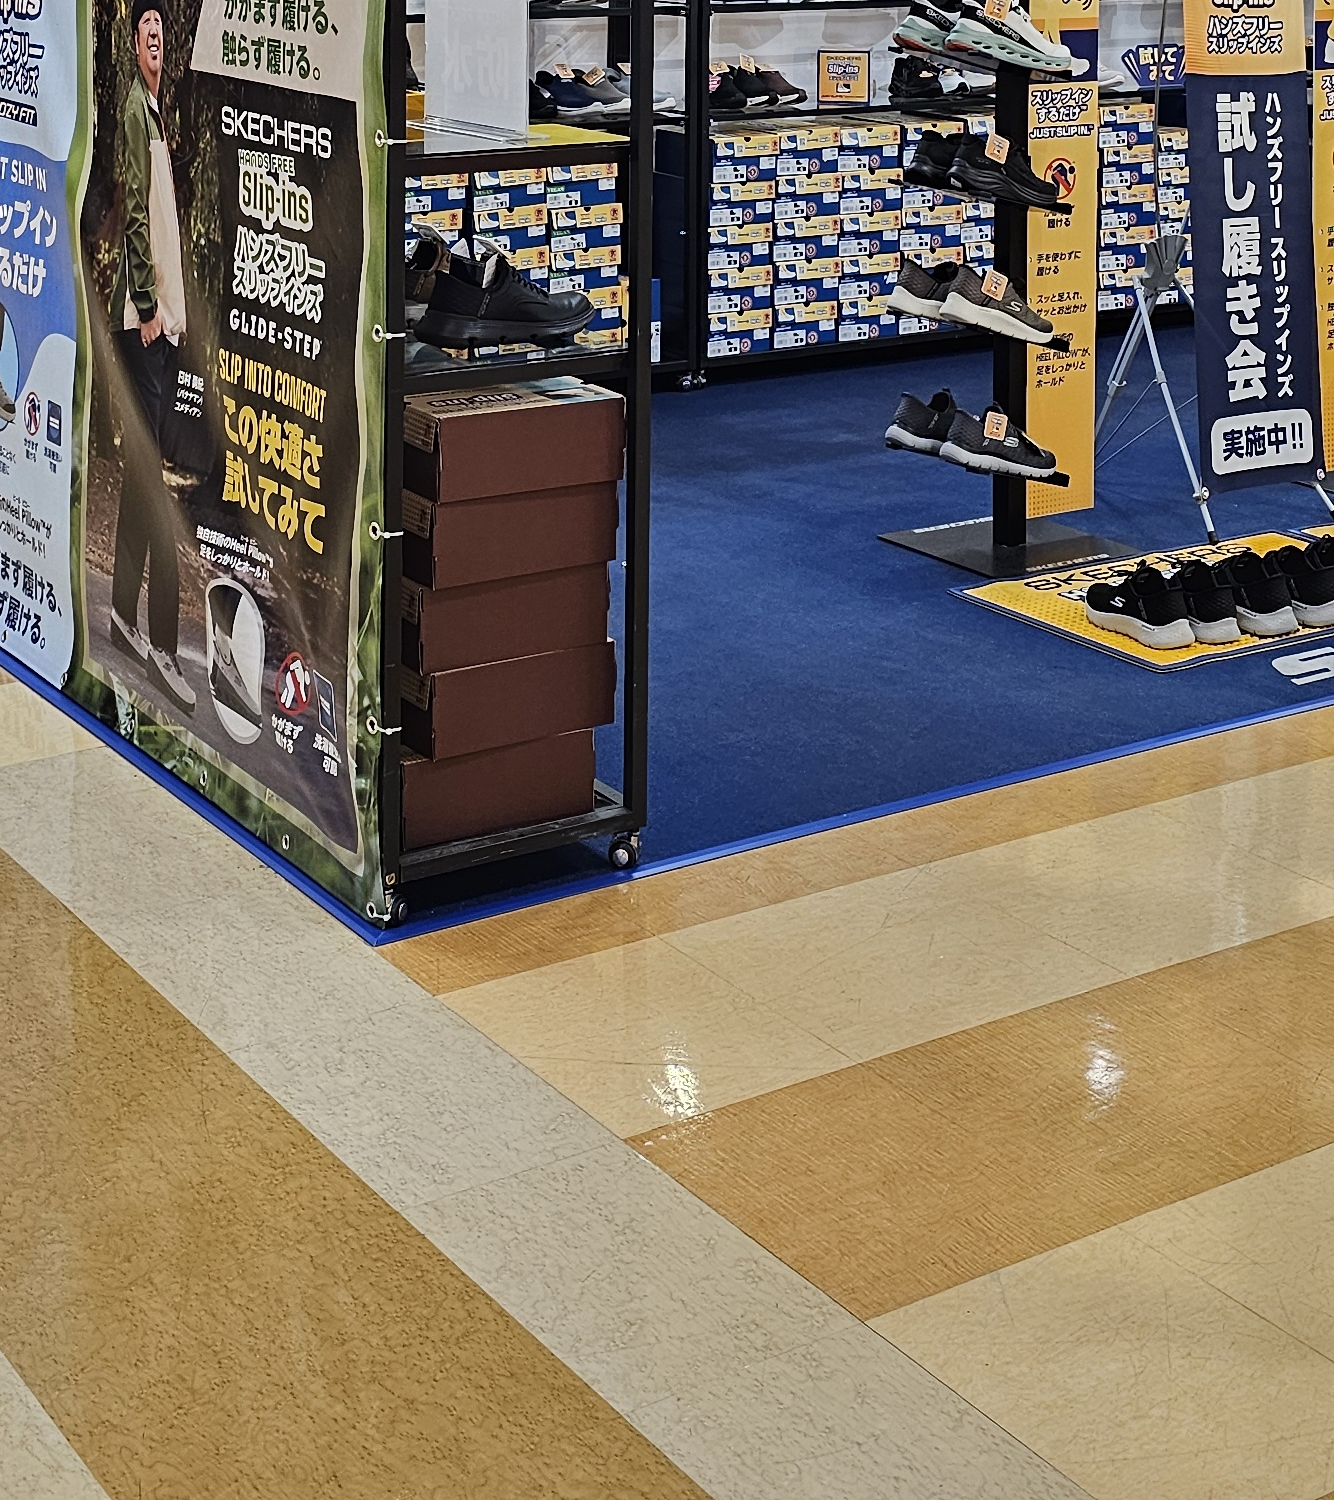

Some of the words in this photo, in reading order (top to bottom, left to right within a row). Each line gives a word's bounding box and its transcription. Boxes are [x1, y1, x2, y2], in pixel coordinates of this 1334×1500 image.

[1207, 14, 1284, 37] ハンズフリー
[221, 29, 321, 81] 触らず履ける。
[1207, 34, 1283, 54] スリップインズ
[1031, 88, 1093, 106] スリップイン
[19, 106, 35, 125] FIT
[221, 105, 332, 159] SKECHERS
[1029, 126, 1056, 139] JUST
[1056, 125, 1076, 138] SLIP
[11, 159, 34, 188] SLIP
[35, 168, 47, 192] IN
[238, 149, 270, 171] HANDS
[270, 155, 296, 177] FREE
[1264, 92, 1284, 229] ハンズフリー
[241, 169, 311, 228] Slip-ins
[234, 225, 326, 282] ハンズフリー
[1036, 251, 1082, 264] 手を使わずに
[1216, 91, 1267, 402] 試し履き会
[1036, 266, 1060, 277] 履ける
[232, 261, 324, 323] スリップインズ
[1036, 291, 1083, 305] スッと足入れ、
[229, 308, 323, 360] GLIDE-STEP
[1269, 237, 1294, 398] スリップインズ
[218, 348, 242, 385] SLIP
[244, 357, 272, 398] INTO
[274, 369, 327, 423] COMFORT
[1035, 361, 1087, 376] 足をしっかりと
[1035, 376, 1065, 389] ホールド
[223, 394, 323, 489] この快適さ
[1222, 422, 1304, 462] 実施中!!
[222, 450, 326, 554] 試してみて
[1025, 553, 1110, 572] SKECHERS
